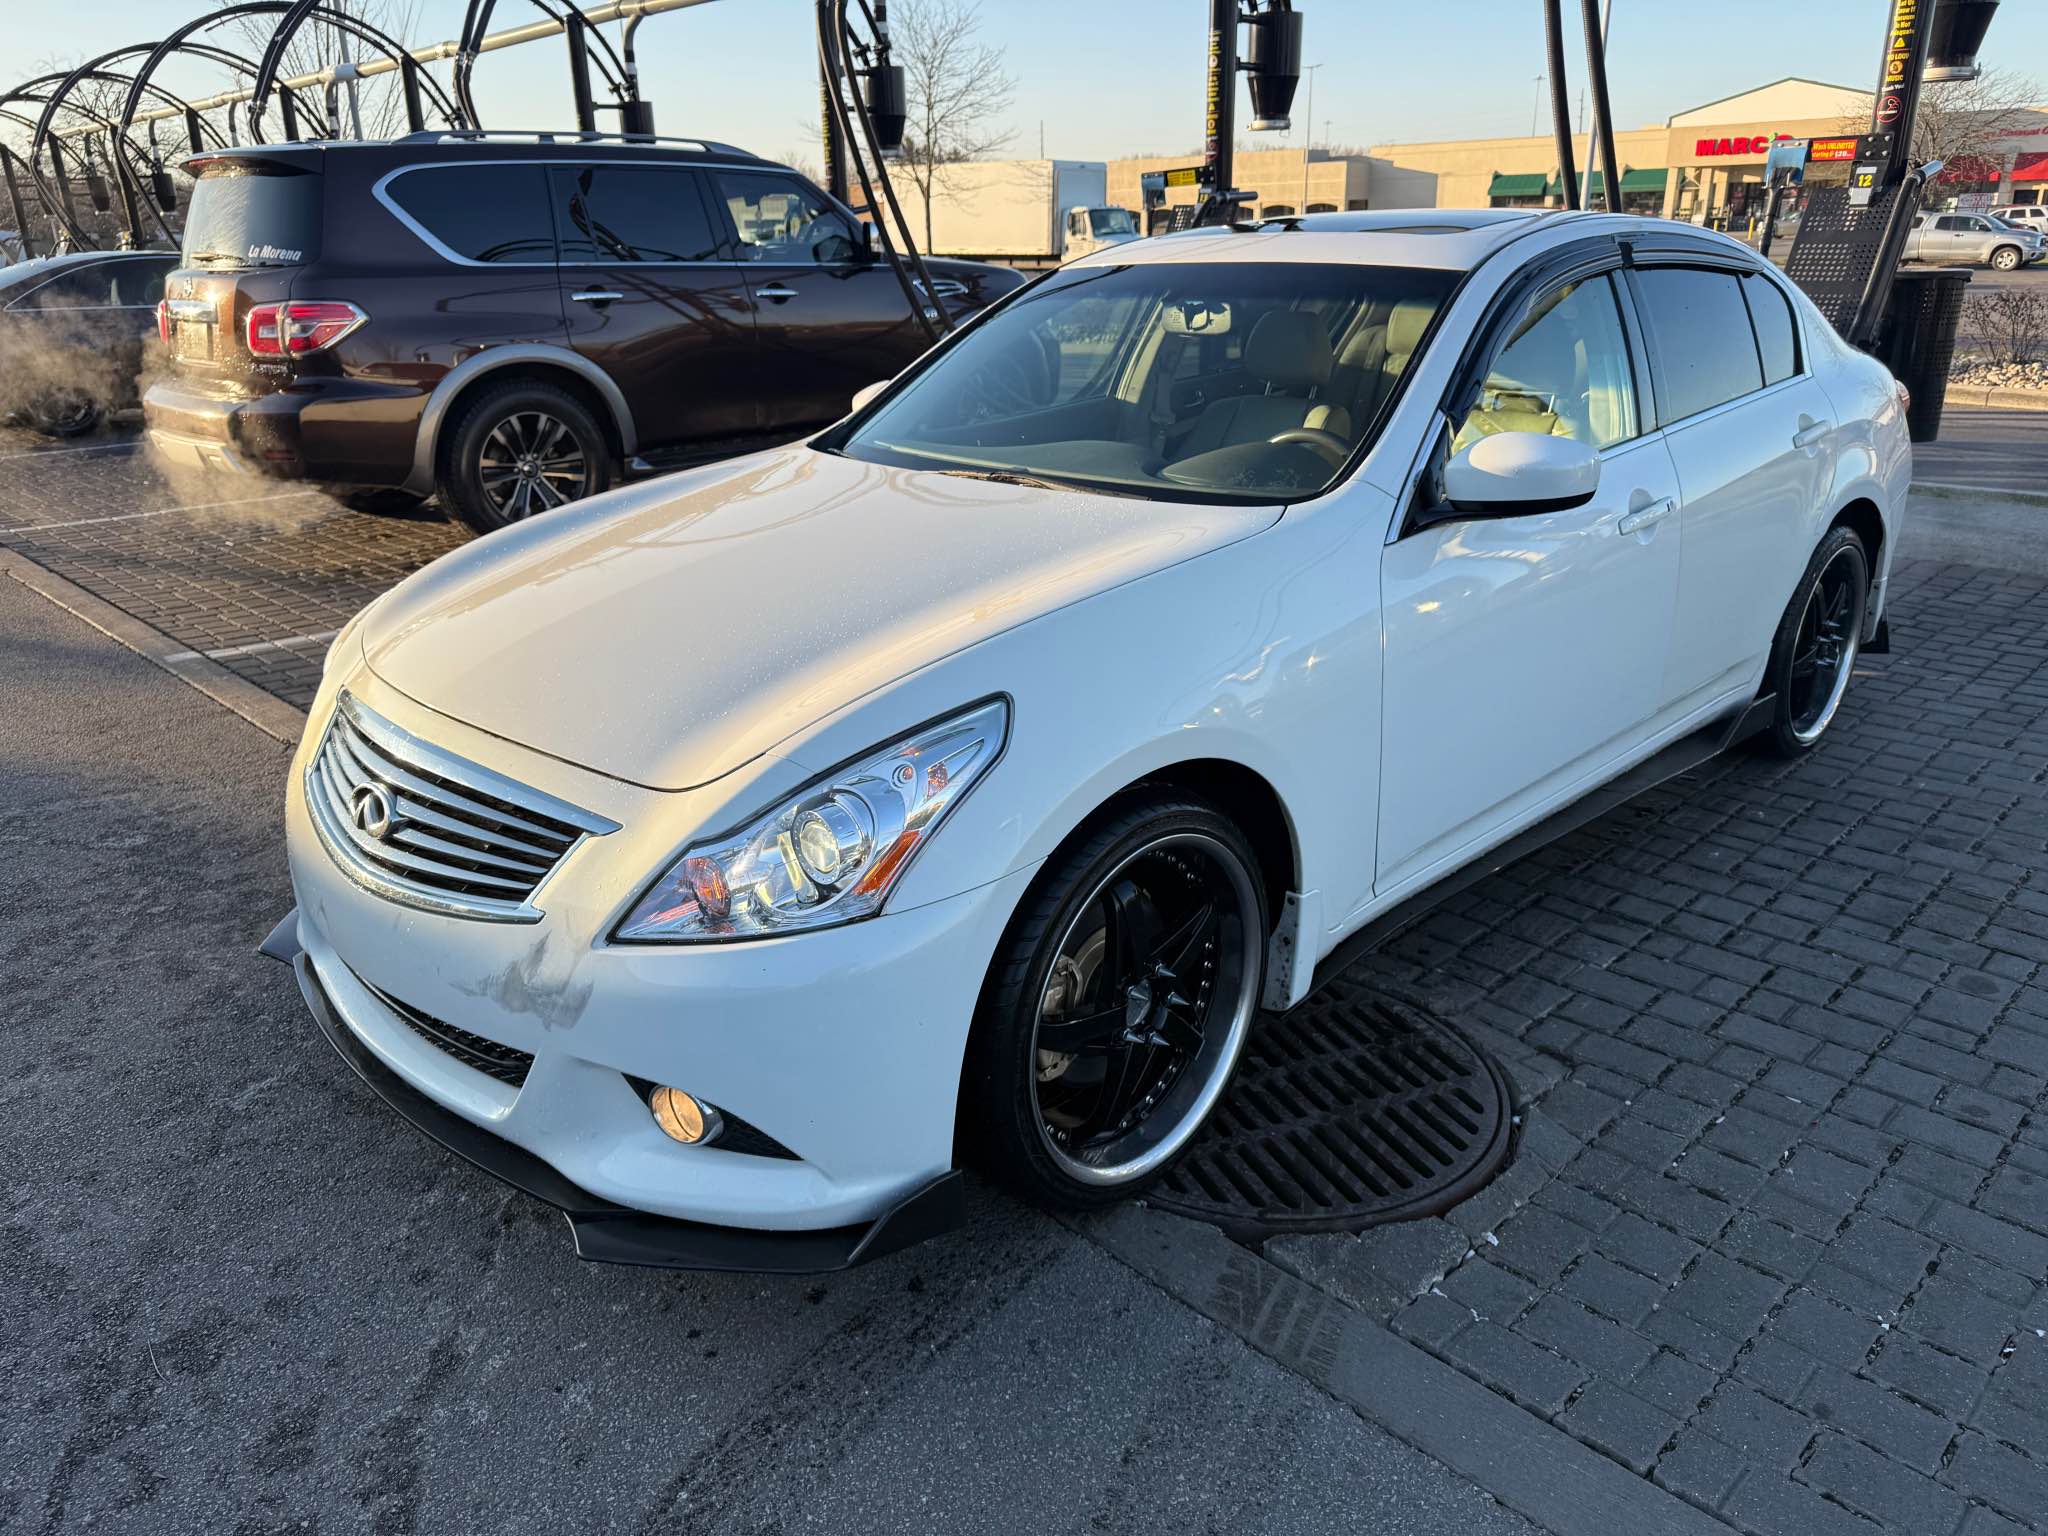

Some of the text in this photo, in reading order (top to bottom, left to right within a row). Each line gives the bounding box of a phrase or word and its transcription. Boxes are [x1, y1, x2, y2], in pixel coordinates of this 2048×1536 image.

[1858, 174, 1873, 187] 12
[248, 244, 303, 261] La Morena
